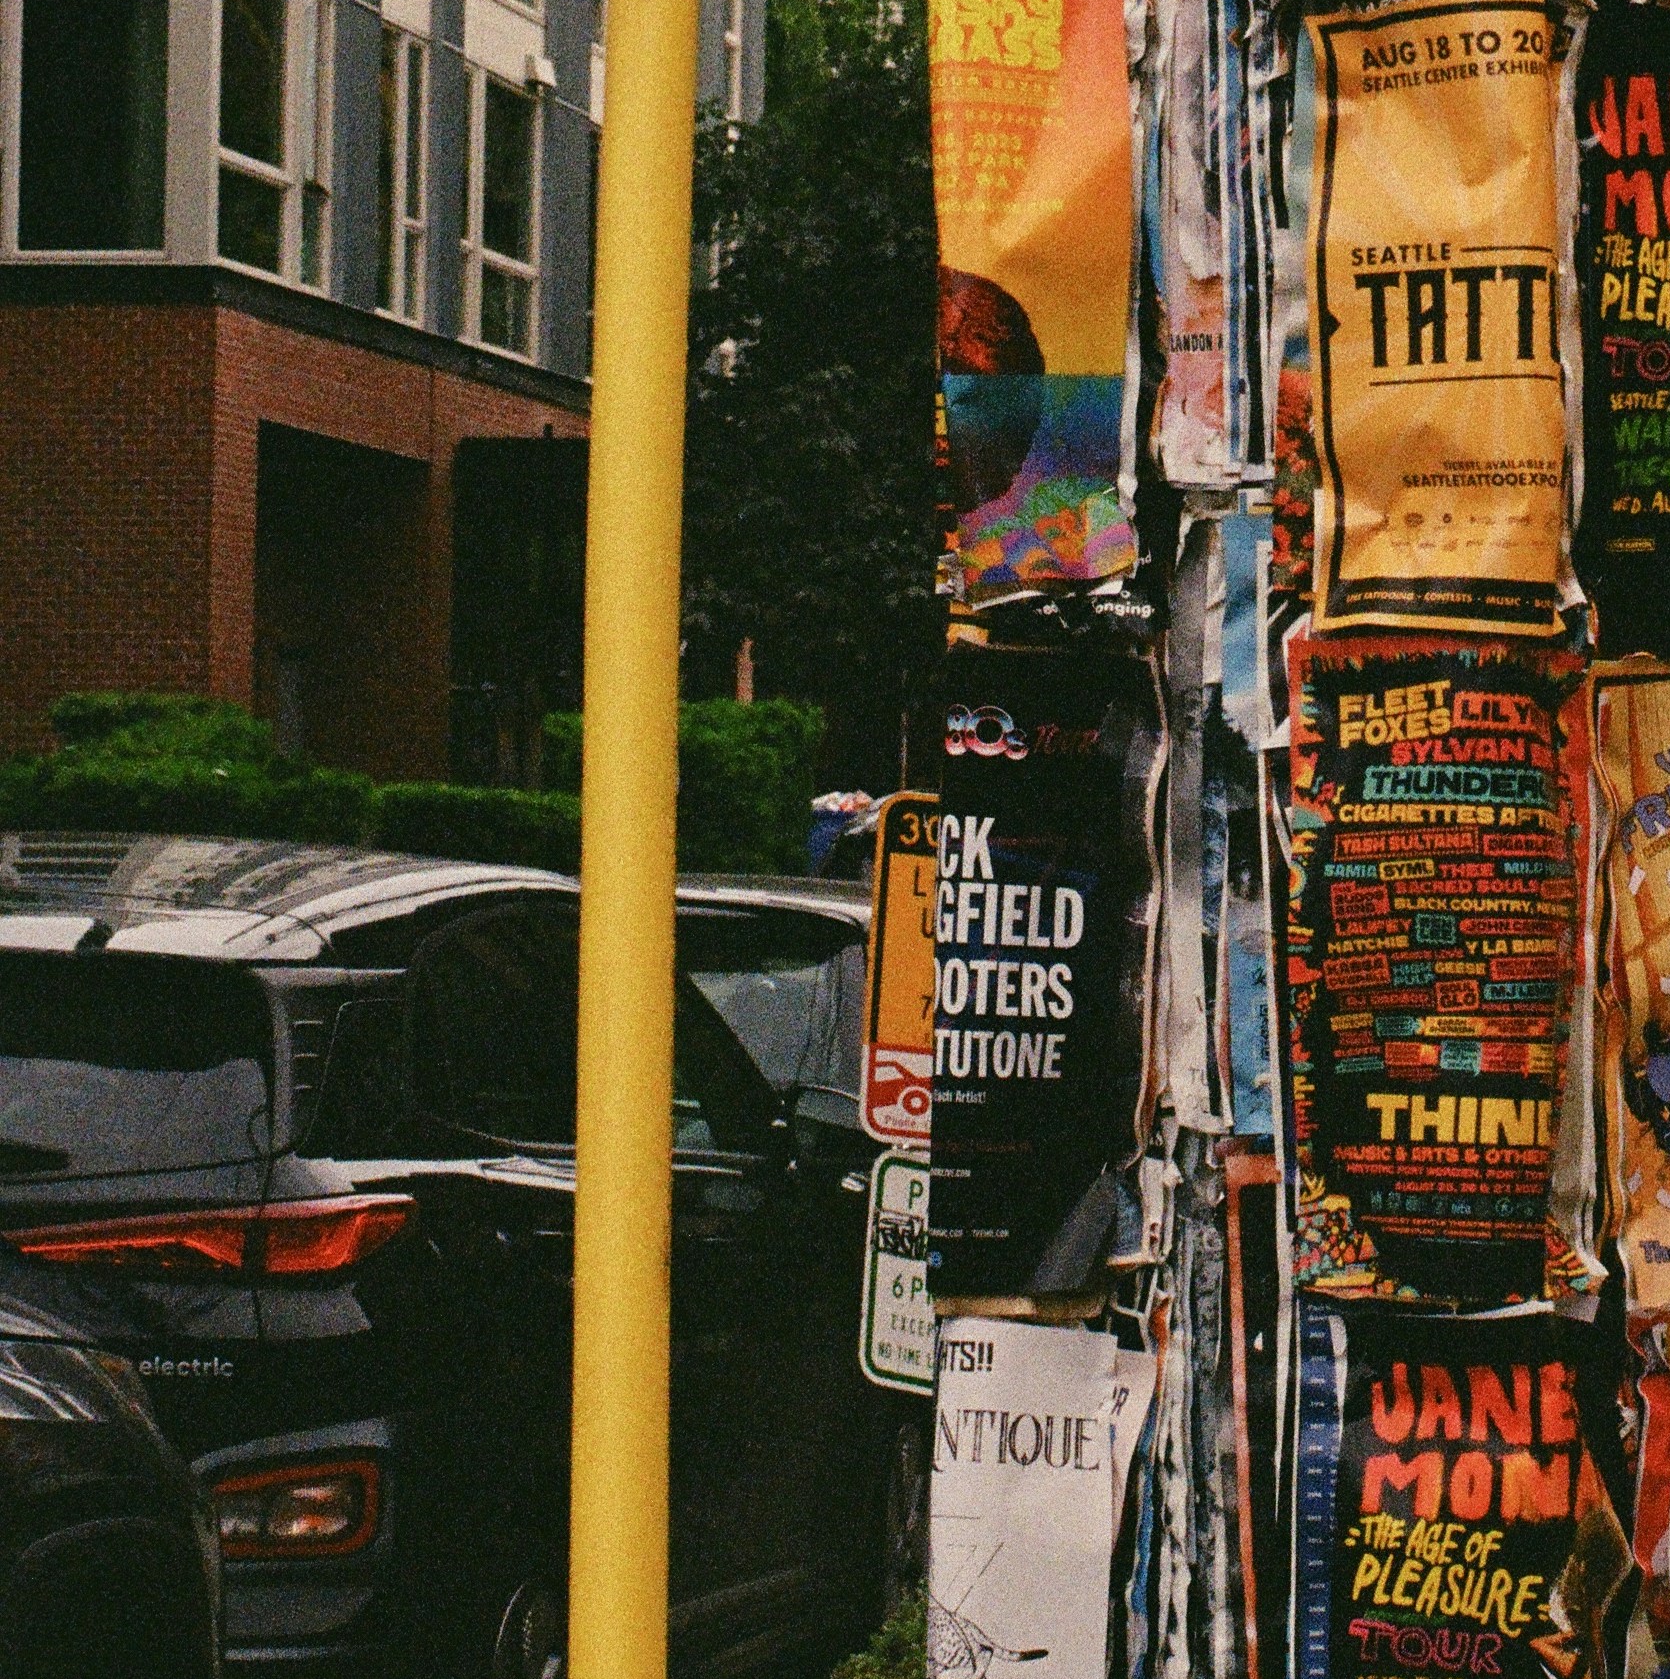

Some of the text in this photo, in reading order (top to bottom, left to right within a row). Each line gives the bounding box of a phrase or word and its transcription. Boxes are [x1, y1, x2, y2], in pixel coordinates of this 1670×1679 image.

[1361, 29, 1545, 72] AUG 18 TO 20
[1361, 60, 1550, 94] SEATTLE CENTER EXHIB
[1350, 241, 1452, 268] SEATTLE
[1603, 231, 1634, 269] THE
[1338, 680, 1452, 721] FLEET
[1339, 707, 1452, 749] FOXES
[1391, 738, 1526, 765] SYLVAN
[1339, 804, 1496, 825] CIGARETTES
[1388, 831, 1474, 852] SULTANA
[1476, 879, 1539, 894] SOULS
[1393, 897, 1449, 912] BLACK
[1482, 939, 1508, 955] LA
[1333, 1145, 1392, 1162] MUSIC
[1412, 1146, 1460, 1163] ARTS
[139, 1355, 235, 1380] electric
[1359, 1512, 1504, 1568] THE AGE OF
[1352, 1553, 1545, 1639] PLEASURE
[1348, 1617, 1504, 1675] TOUR
